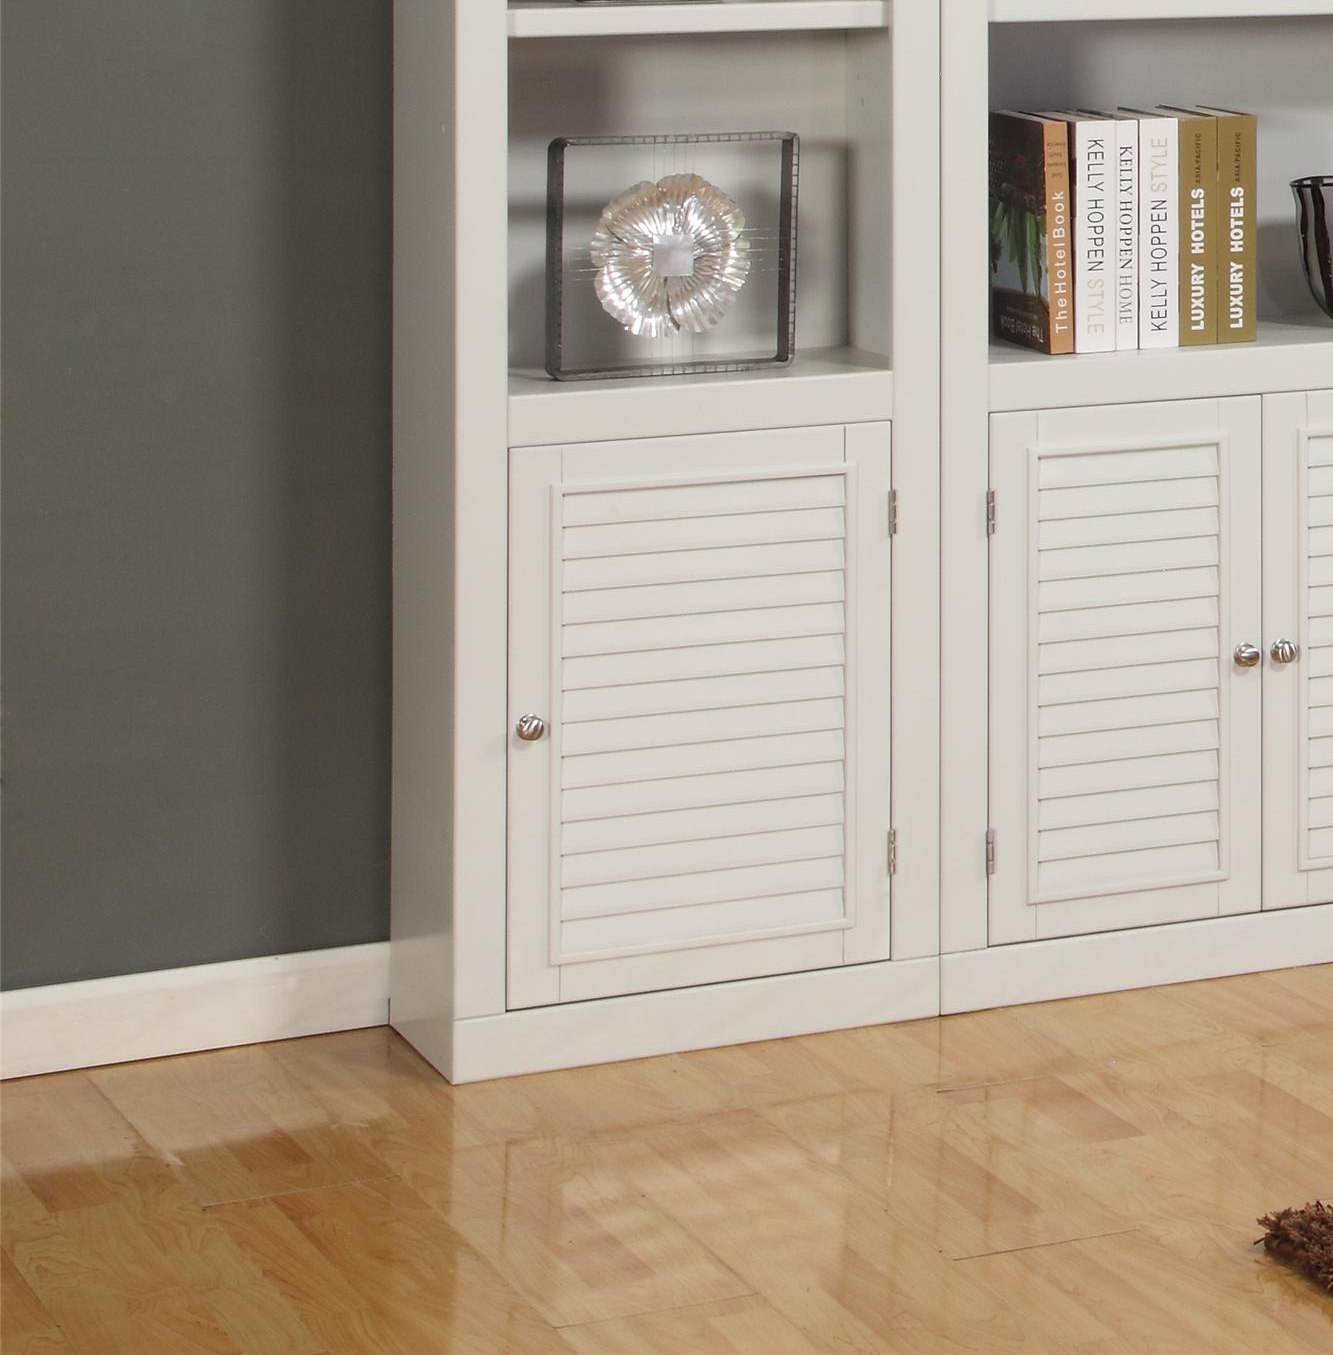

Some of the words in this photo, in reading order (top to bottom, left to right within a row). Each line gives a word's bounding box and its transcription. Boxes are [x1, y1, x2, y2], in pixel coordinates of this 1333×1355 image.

[1087, 139, 1104, 192] KELLY
[1119, 146, 1133, 195] KELLY
[1150, 138, 1168, 192] STYLE
[1087, 199, 1104, 272] HOPPEN
[1119, 201, 1133, 269] HOPPEN
[1151, 200, 1168, 272] HOPPEN
[1191, 188, 1205, 254] HOTELS
[1230, 186, 1244, 252] HOTELS
[1087, 278, 1104, 335] STYLE
[1120, 276, 1133, 324] HOME
[1151, 279, 1168, 332] KELLY
[1191, 263, 1205, 330] LUXURY
[1230, 261, 1244, 329] LUXURY
